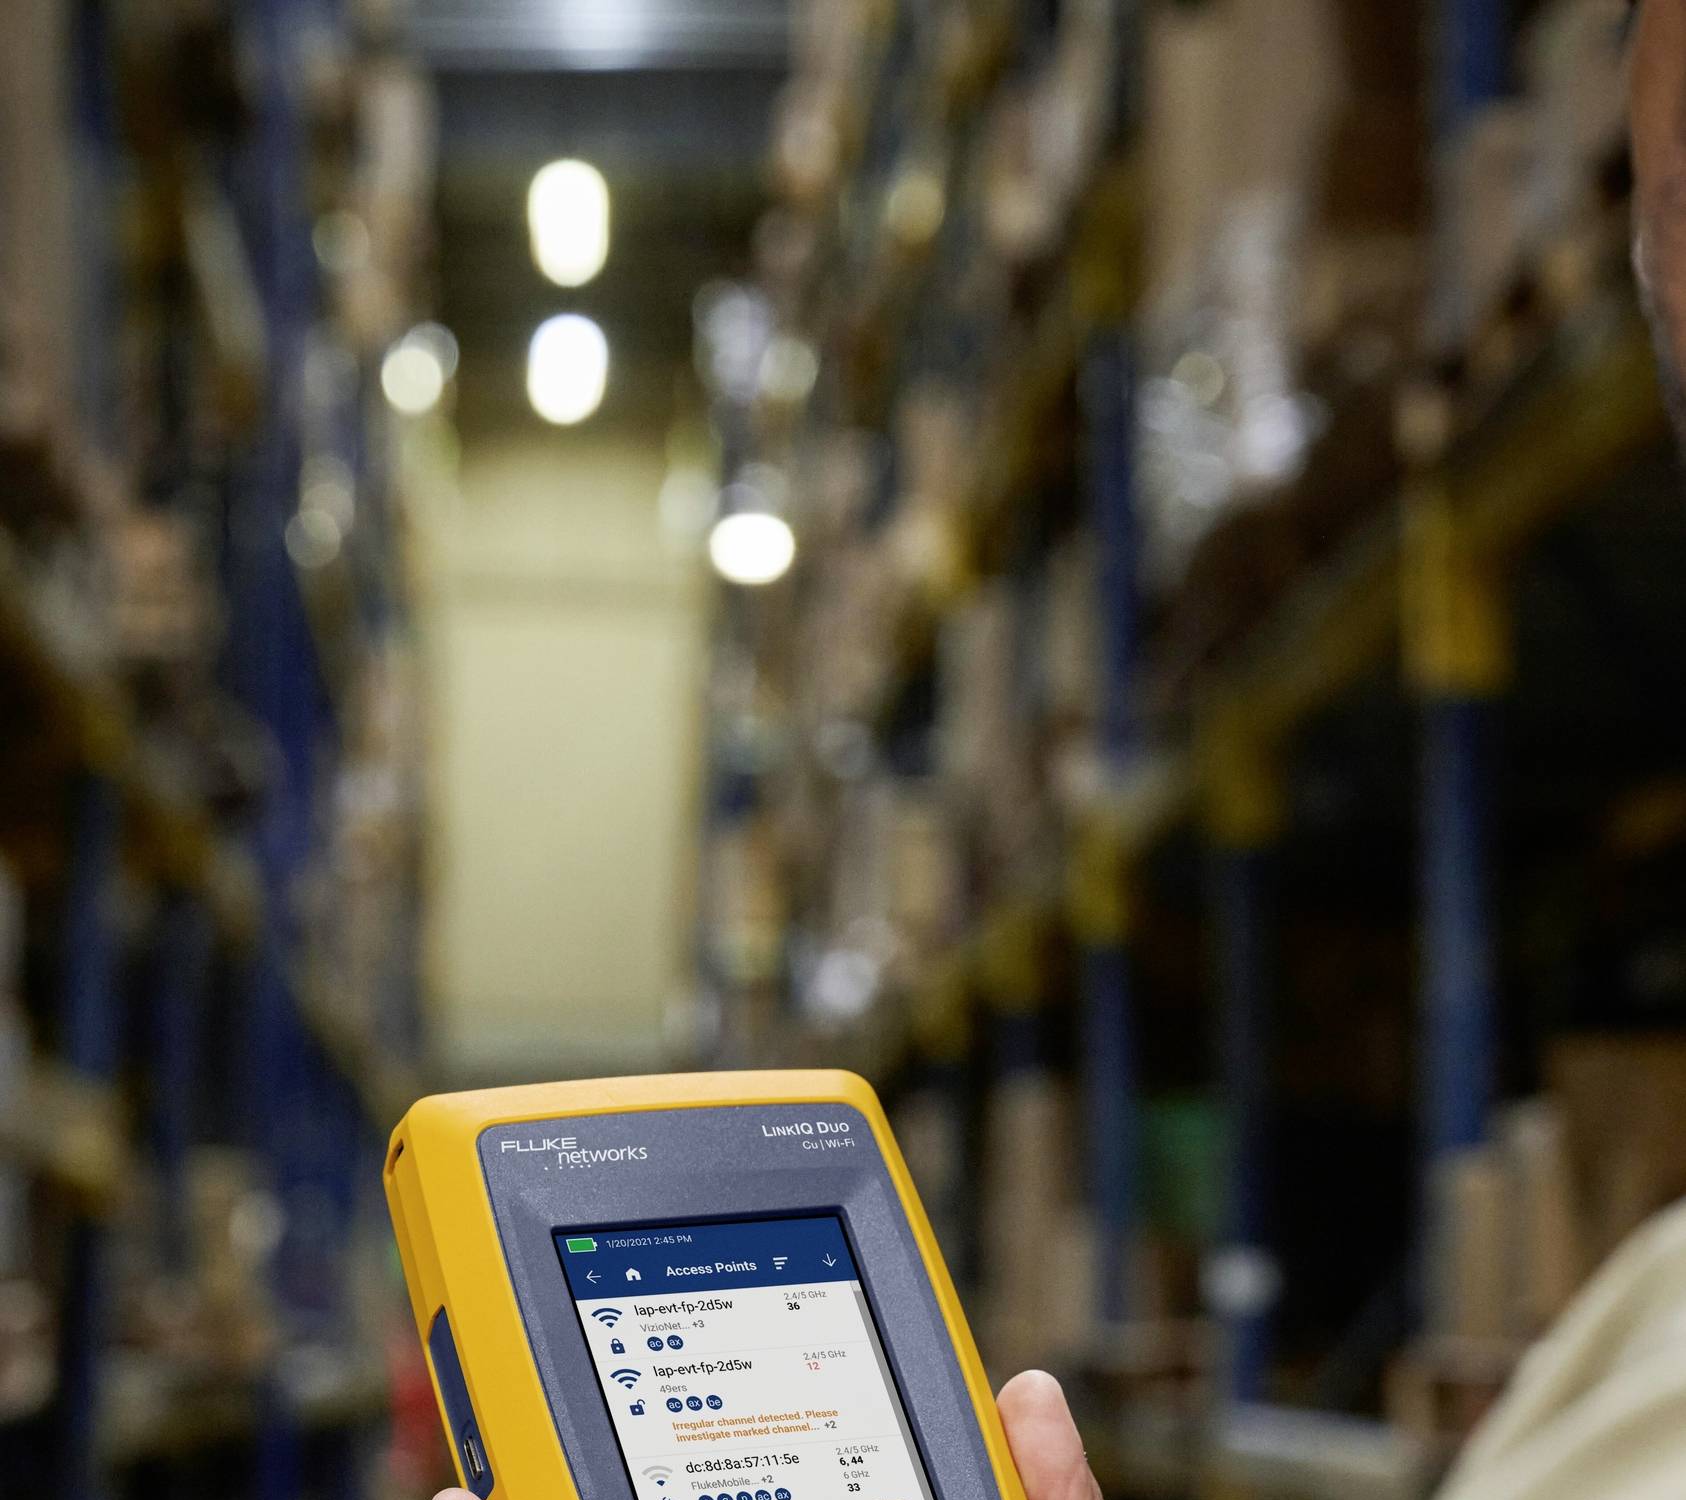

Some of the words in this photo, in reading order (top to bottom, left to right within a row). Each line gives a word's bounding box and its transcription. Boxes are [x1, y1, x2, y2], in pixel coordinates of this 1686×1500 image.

[501, 1137, 577, 1153] FLUKE
[802, 1140, 818, 1150] Cu
[825, 1138, 855, 1148] Wi-Fi
[558, 1146, 648, 1164] networks
[606, 1238, 652, 1248] 1/20/2021
[654, 1236, 675, 1245] 2:45
[676, 1234, 692, 1243] PM
[666, 1264, 713, 1277] Access
[715, 1260, 757, 1273] Points
[783, 1291, 807, 1300] 2.4/5
[808, 1290, 827, 1299] GHz
[634, 1299, 733, 1317] lap-evt-fp-2d5w
[786, 1302, 800, 1311] 36
[692, 1319, 705, 1328] +3
[649, 1340, 662, 1348] ac
[669, 1338, 682, 1347] ax
[802, 1351, 827, 1361] 2.4/5
[827, 1350, 847, 1359] GHz
[653, 1359, 753, 1378] lap-evt-fp-2d5w
[806, 1361, 821, 1371] 12
[660, 1384, 688, 1394] 49ers
[668, 1400, 681, 1409] ac
[688, 1398, 701, 1408] ax
[707, 1396, 722, 1407] be
[672, 1420, 715, 1431] Irregular
[717, 1415, 756, 1427] channel
[757, 1411, 804, 1423] detected.
[805, 1409, 839, 1419] Please
[676, 1429, 732, 1443] investigate
[733, 1426, 770, 1438] marked
[772, 1422, 821, 1434] channel...
[823, 1419, 838, 1429] +2
[835, 1446, 859, 1456] 2.4/5
[860, 1444, 880, 1453] GHz
[685, 1453, 800, 1474] dc:8d:8a:57:11:5e
[839, 1457, 850, 1467] 6,
[851, 1455, 864, 1465] 44
[760, 1474, 775, 1484] +2
[843, 1471, 850, 1480] 6
[850, 1470, 870, 1479] GHz
[847, 1482, 861, 1492] 33
[776, 1490, 790, 1500] ax
